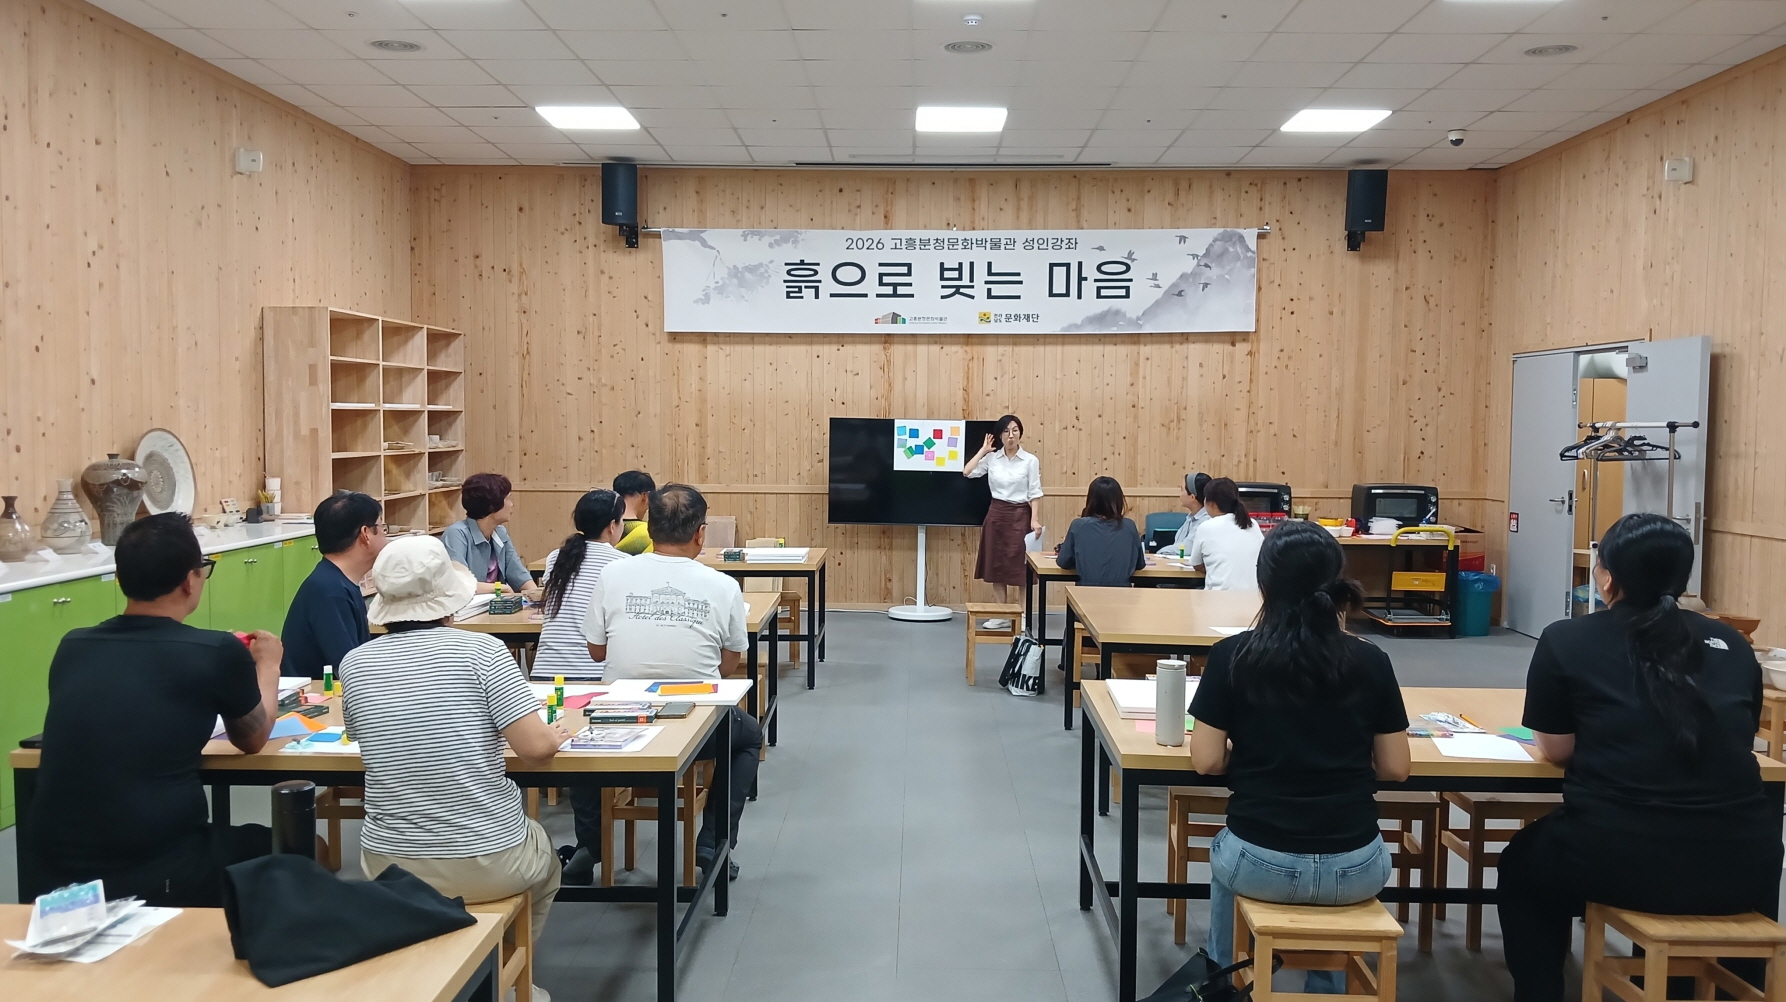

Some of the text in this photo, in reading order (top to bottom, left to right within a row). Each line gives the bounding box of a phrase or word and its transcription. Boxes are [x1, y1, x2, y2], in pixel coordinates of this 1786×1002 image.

[845, 237, 1079, 251] 2026 고흥분청문화박물관 성인강좌
[782, 259, 1134, 300] 흙으로 빚는 마음
[1004, 313, 1040, 323] 문화재단
